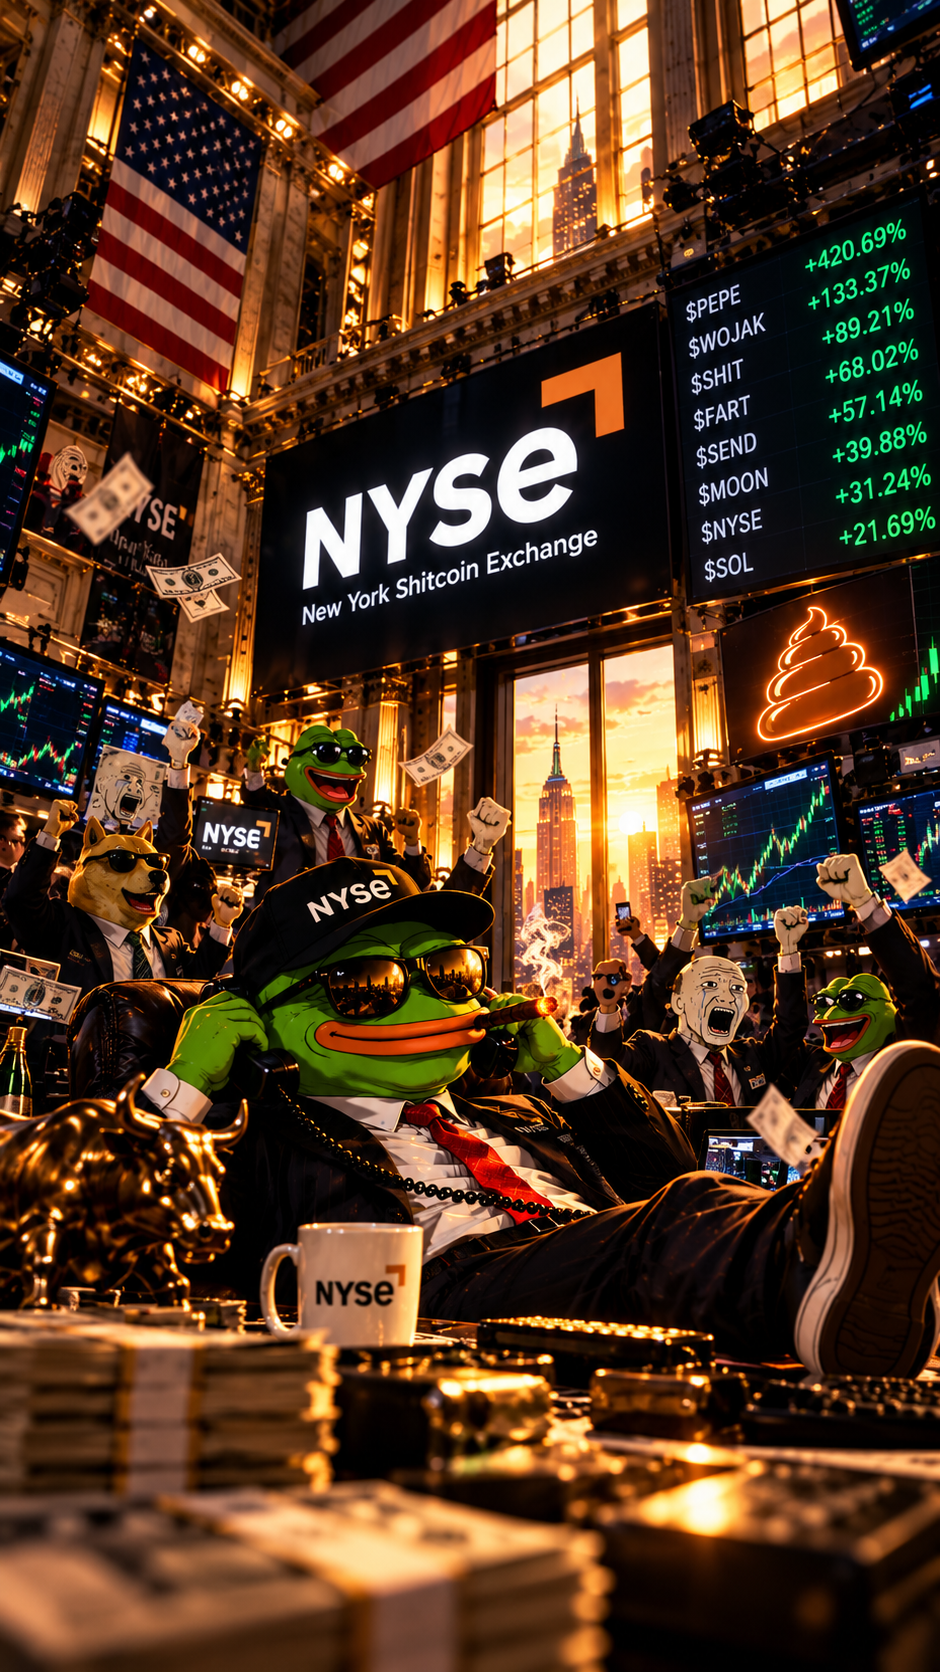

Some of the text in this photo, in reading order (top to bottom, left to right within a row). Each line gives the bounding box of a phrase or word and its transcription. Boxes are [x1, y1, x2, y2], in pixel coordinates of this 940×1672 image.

[685, 218, 907, 323] $PEPE +420.69%
[688, 257, 911, 359] $WOJAK +133.37%
[691, 298, 915, 395] $SHIT +89.21%
[693, 338, 919, 431] $FART +68.02%
[696, 379, 923, 469] $SEND +57.14%
[698, 421, 927, 506] $MOON +39.88%
[128, 493, 178, 541] YSE
[701, 463, 932, 544] $NYSE +31.24%
[704, 505, 936, 582] $SOL +21.69%
[302, 529, 598, 626] New York Shitcoin Exchange
